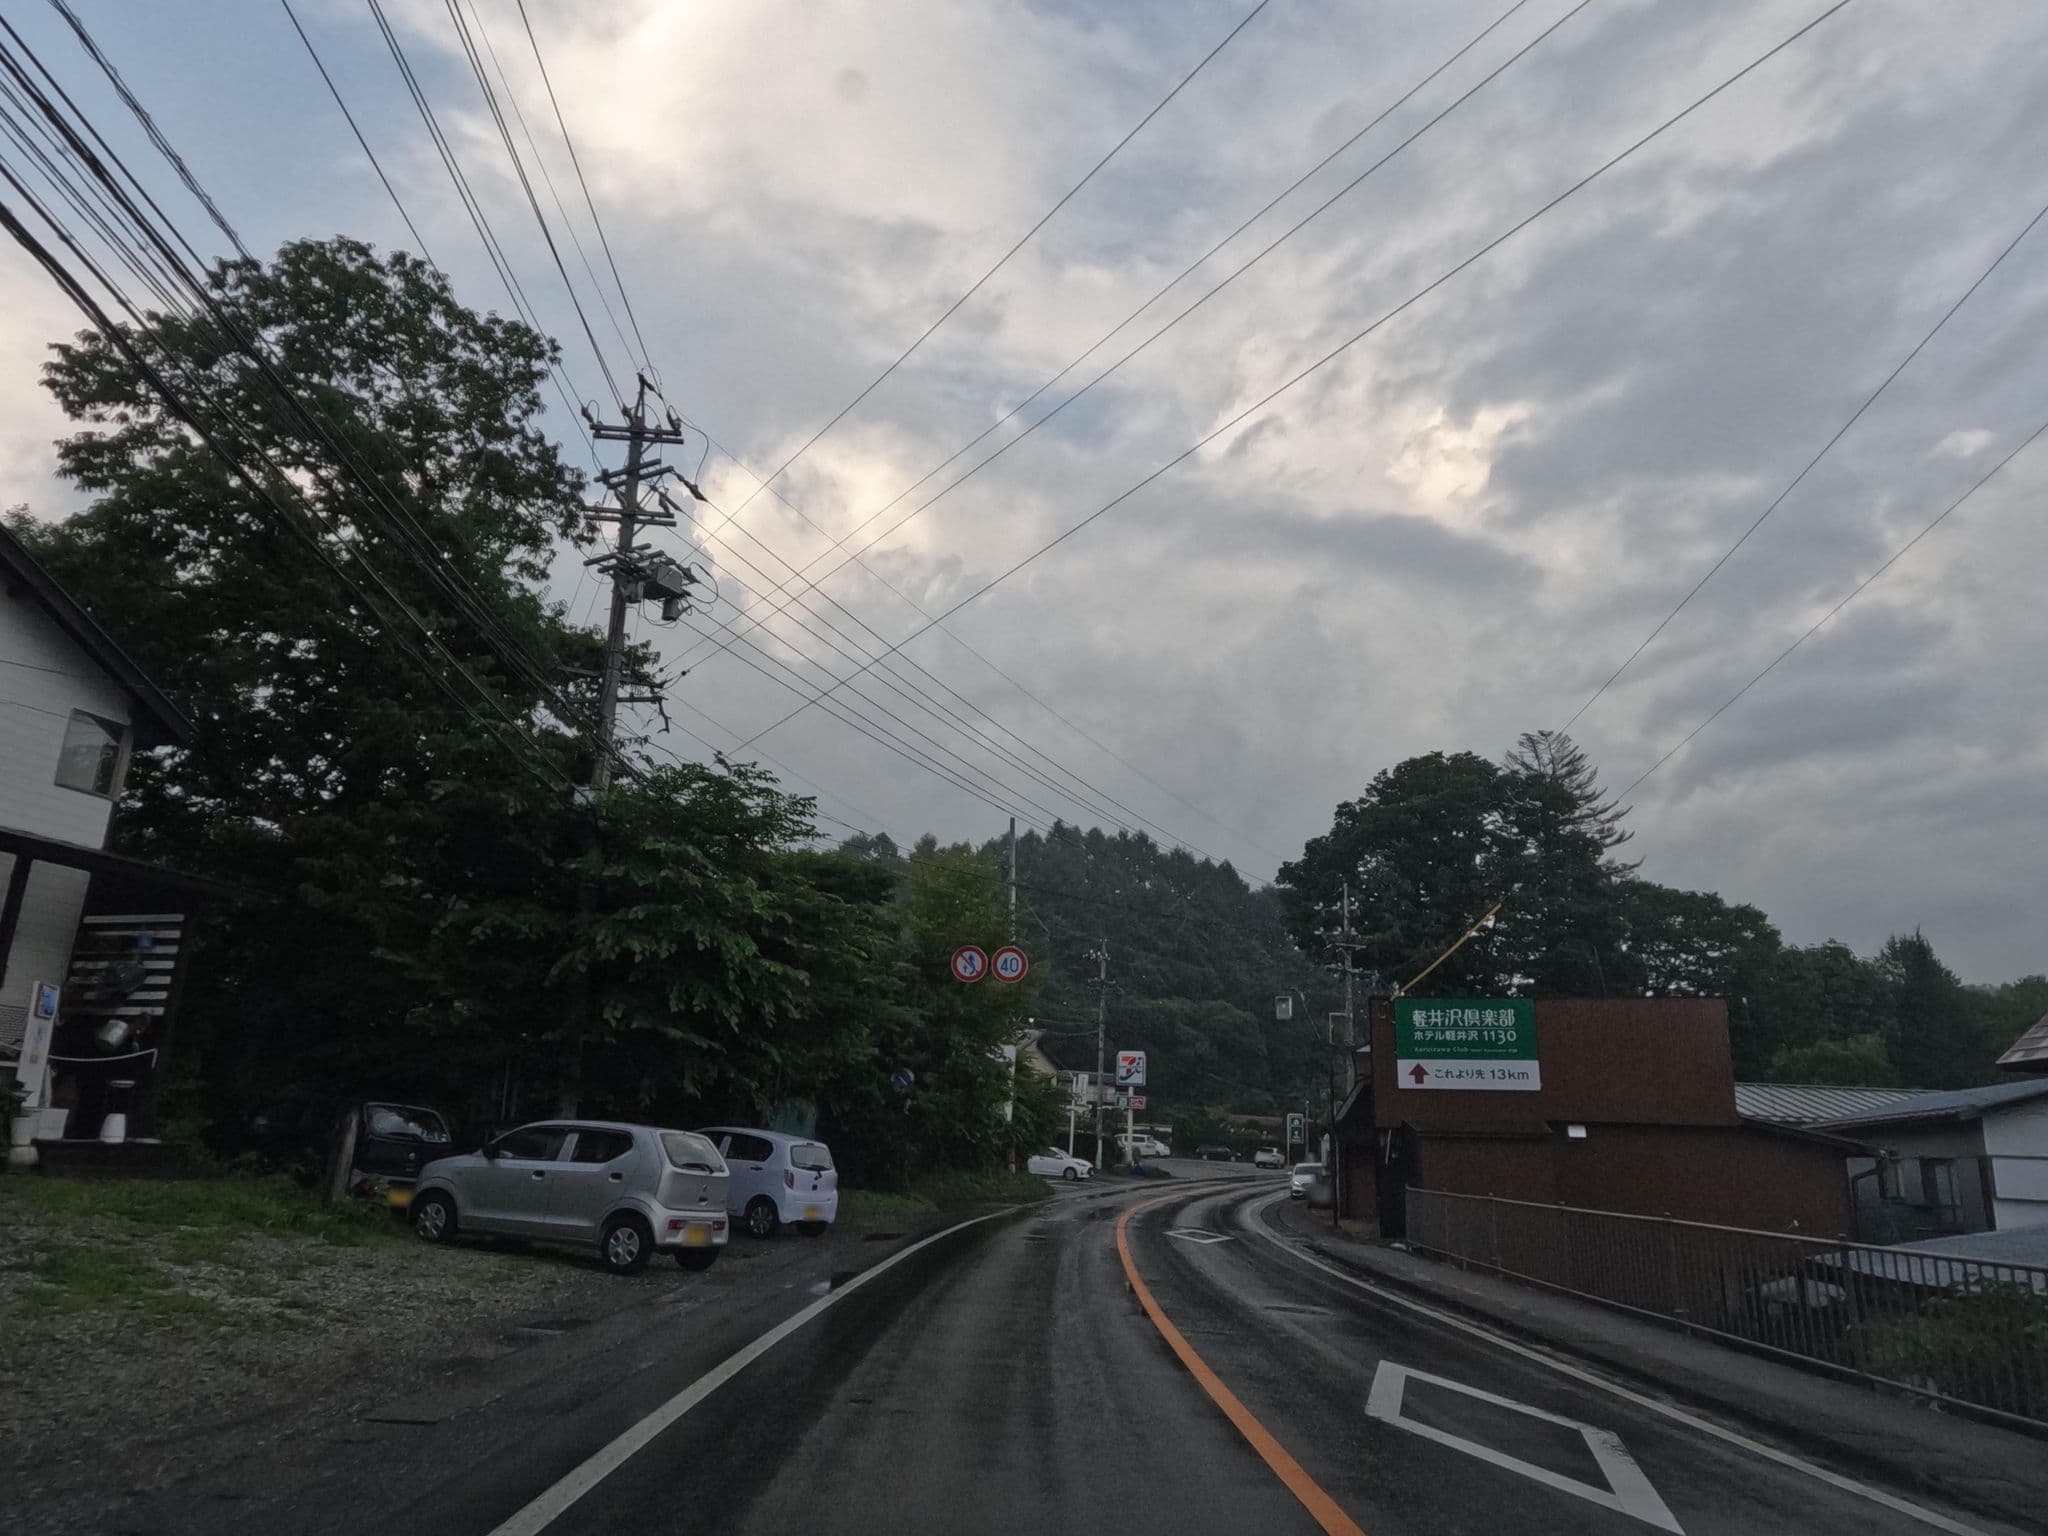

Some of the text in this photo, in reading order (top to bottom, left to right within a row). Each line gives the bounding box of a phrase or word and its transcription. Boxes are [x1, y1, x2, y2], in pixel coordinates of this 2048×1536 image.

[1001, 957, 1019, 973] 40
[1412, 1008, 1516, 1028] 軽井沢倶楽部
[1414, 1030, 1517, 1044] ホテル軽井沢 1130
[1434, 1068, 1530, 1081] これより先 13km
